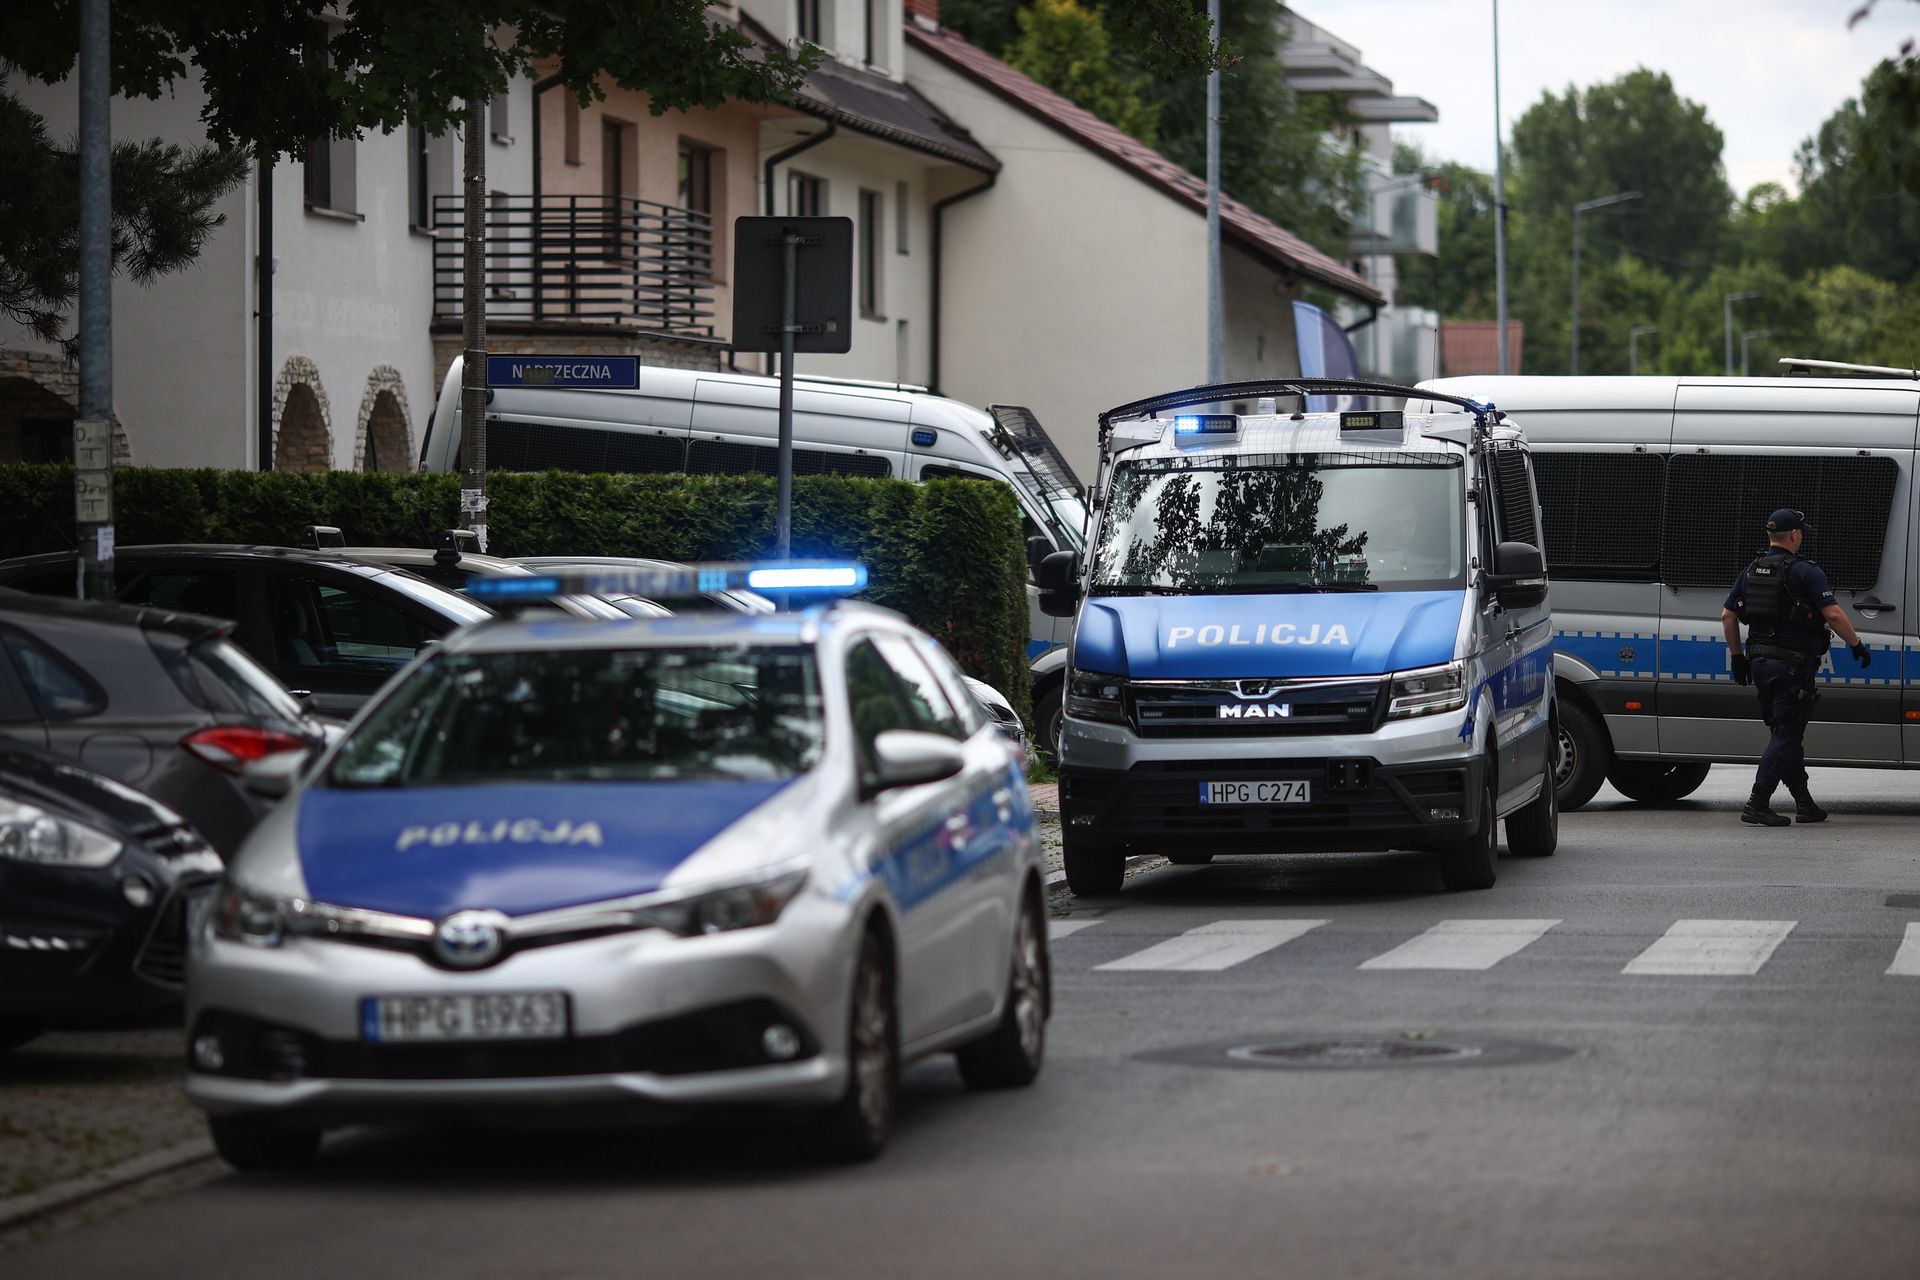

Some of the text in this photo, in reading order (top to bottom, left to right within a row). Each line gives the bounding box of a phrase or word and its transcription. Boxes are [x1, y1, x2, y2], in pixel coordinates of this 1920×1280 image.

[512, 364, 612, 379] NZECZNA
[1167, 623, 1350, 648] POLICJA
[1219, 704, 1290, 718] MAN
[1212, 783, 1306, 802] HPG C274
[397, 818, 604, 851] POLICJA
[382, 994, 463, 1037] HPG
[471, 992, 557, 1035] B963
